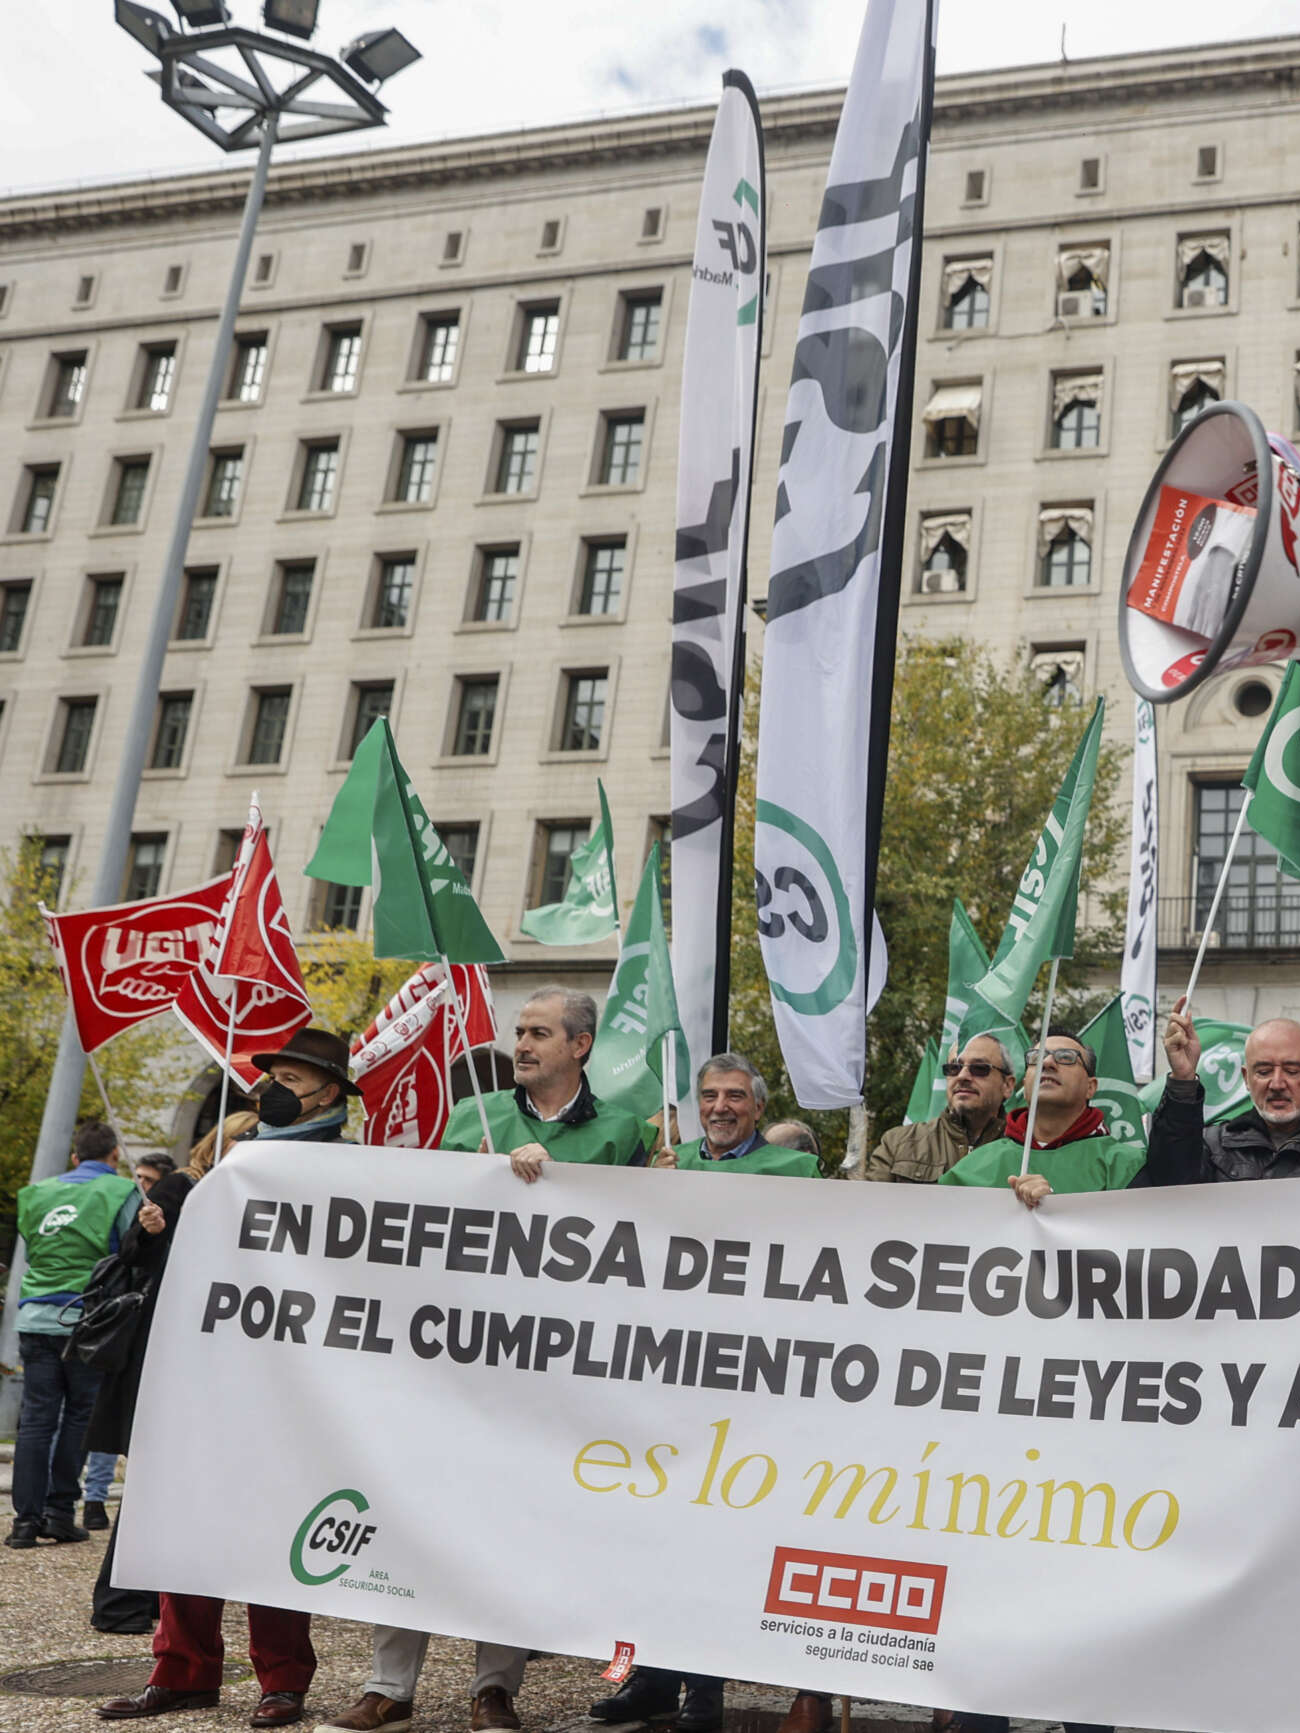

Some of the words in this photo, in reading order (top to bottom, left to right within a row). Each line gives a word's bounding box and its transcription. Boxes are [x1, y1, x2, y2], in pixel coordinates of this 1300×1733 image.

[1144, 498, 1188, 608] MANIFESTACIÓN
[239, 1199, 312, 1256] EN
[325, 1197, 645, 1287] DEFENSA
[663, 1236, 750, 1296] DE
[764, 1244, 848, 1304] LA
[201, 1282, 315, 1345] POR
[324, 1296, 393, 1355] EL
[410, 1304, 879, 1402] CUMPLIMIENTO
[895, 1349, 985, 1412] DE
[999, 1357, 1203, 1426] LEYES
[1221, 1363, 1266, 1427] Y
[574, 1440, 678, 1498] es
[693, 1418, 778, 1509] lo
[803, 1441, 1180, 1552] mínimo
[309, 1517, 377, 1556] CSIF
[339, 1578, 384, 1594] SEGURIDAD
[387, 1585, 416, 1599] SOCIAL
[779, 1561, 935, 1620] CCOO
[760, 1619, 824, 1638] servicios
[828, 1629, 836, 1640] a
[840, 1627, 853, 1641] la
[857, 1630, 936, 1653] ciudadanía
[805, 1644, 868, 1663] seguridad
[871, 1654, 910, 1668] social
[912, 1658, 934, 1672] sae
